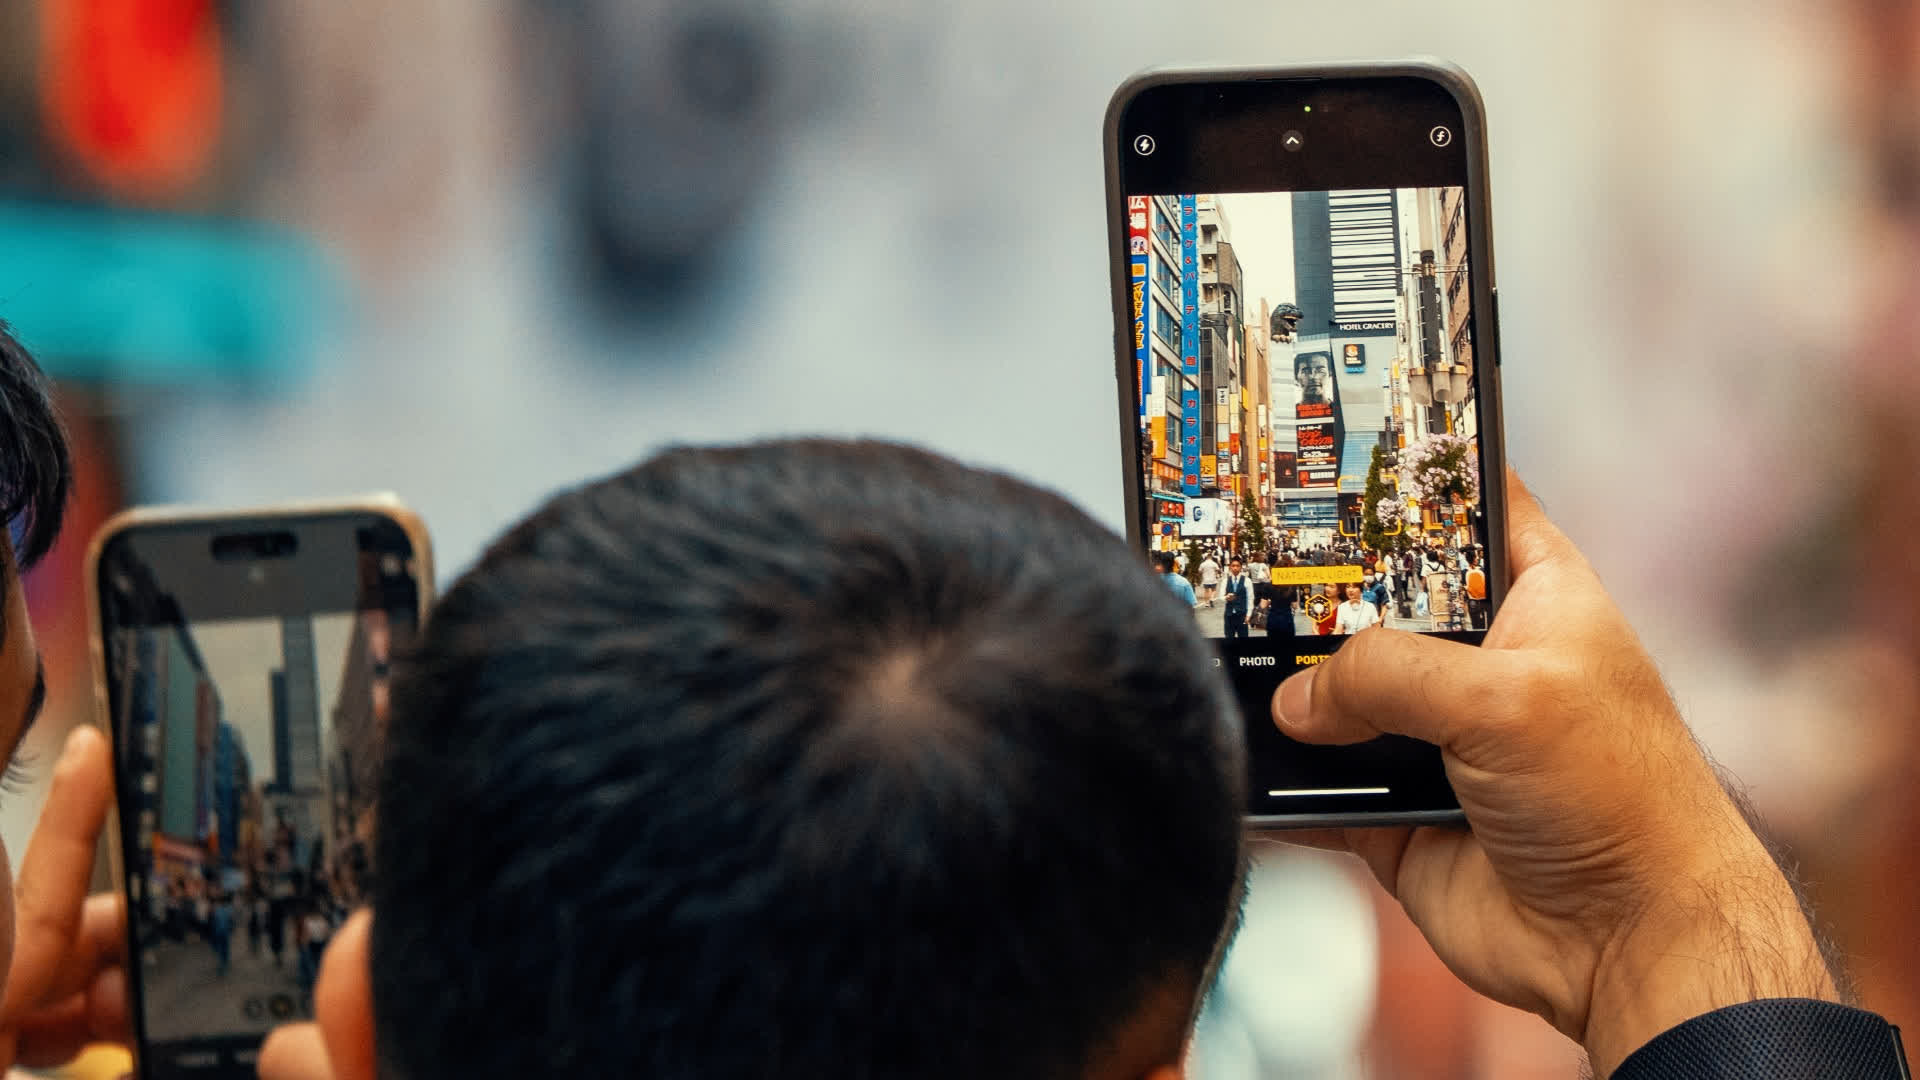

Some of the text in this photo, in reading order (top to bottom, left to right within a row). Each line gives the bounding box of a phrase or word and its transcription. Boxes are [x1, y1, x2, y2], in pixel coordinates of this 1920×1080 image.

[1339, 322, 1395, 331] HOTEL GRACERY
[1277, 569, 1357, 581] NATURAL LIGHT
[1239, 656, 1276, 667] PHOTO
